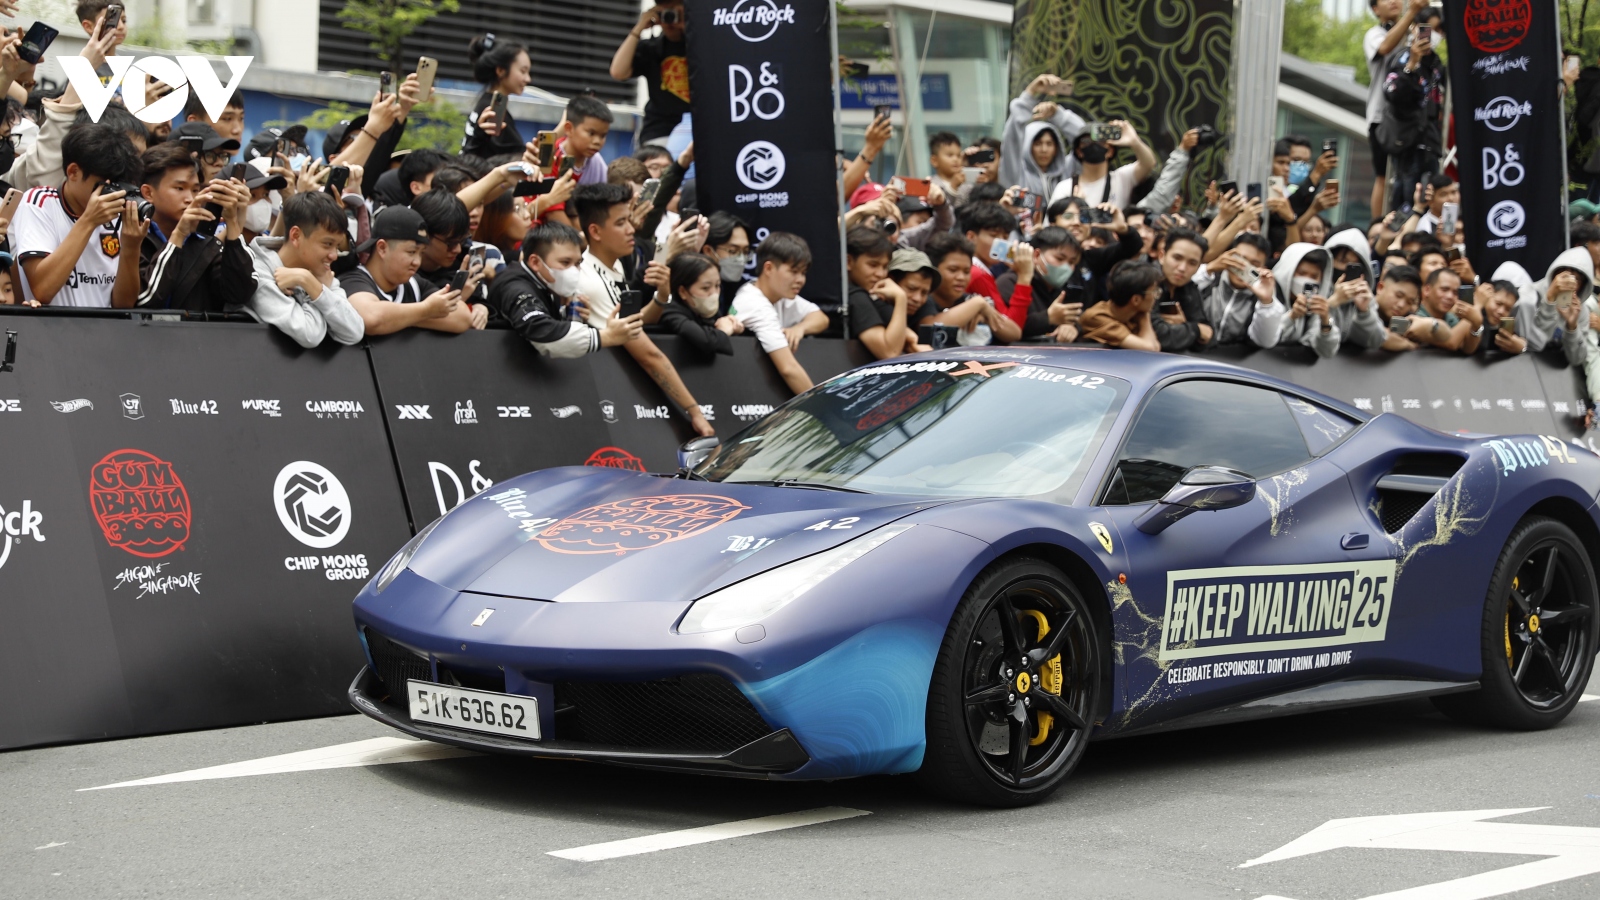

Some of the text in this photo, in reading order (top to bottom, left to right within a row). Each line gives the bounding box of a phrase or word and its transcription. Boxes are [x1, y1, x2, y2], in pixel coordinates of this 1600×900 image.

[713, 3, 795, 25] Hard Rock
[1474, 100, 1532, 121] Hard Rock
[735, 192, 789, 203] CHIP MONG
[759, 200, 789, 208] GROUP
[1009, 365, 1106, 390] Blue 42
[169, 399, 219, 416] Blue 42
[242, 399, 281, 411] WURKZ
[305, 400, 365, 412] CAMBODIA
[633, 404, 670, 419] Blue 42
[1481, 438, 1550, 477] Blue
[1538, 434, 1578, 463] 42
[93, 460, 180, 491] GUM
[94, 488, 188, 518] BALL
[482, 487, 534, 520] Blue
[104, 515, 190, 547] 3000
[803, 516, 861, 532] 42
[284, 554, 368, 571] CHIP MONG
[325, 567, 370, 581] GROUP
[113, 562, 156, 591] SAIGON
[136, 571, 203, 600] SINGAPORE
[1169, 583, 1245, 644] #KEEP
[1246, 577, 1351, 636] WALKING
[1167, 651, 1352, 685] CELEBRATE RESPONSIBLY. DON'T DRINK AND DRIVE
[418, 689, 527, 730] 51K-636.62
